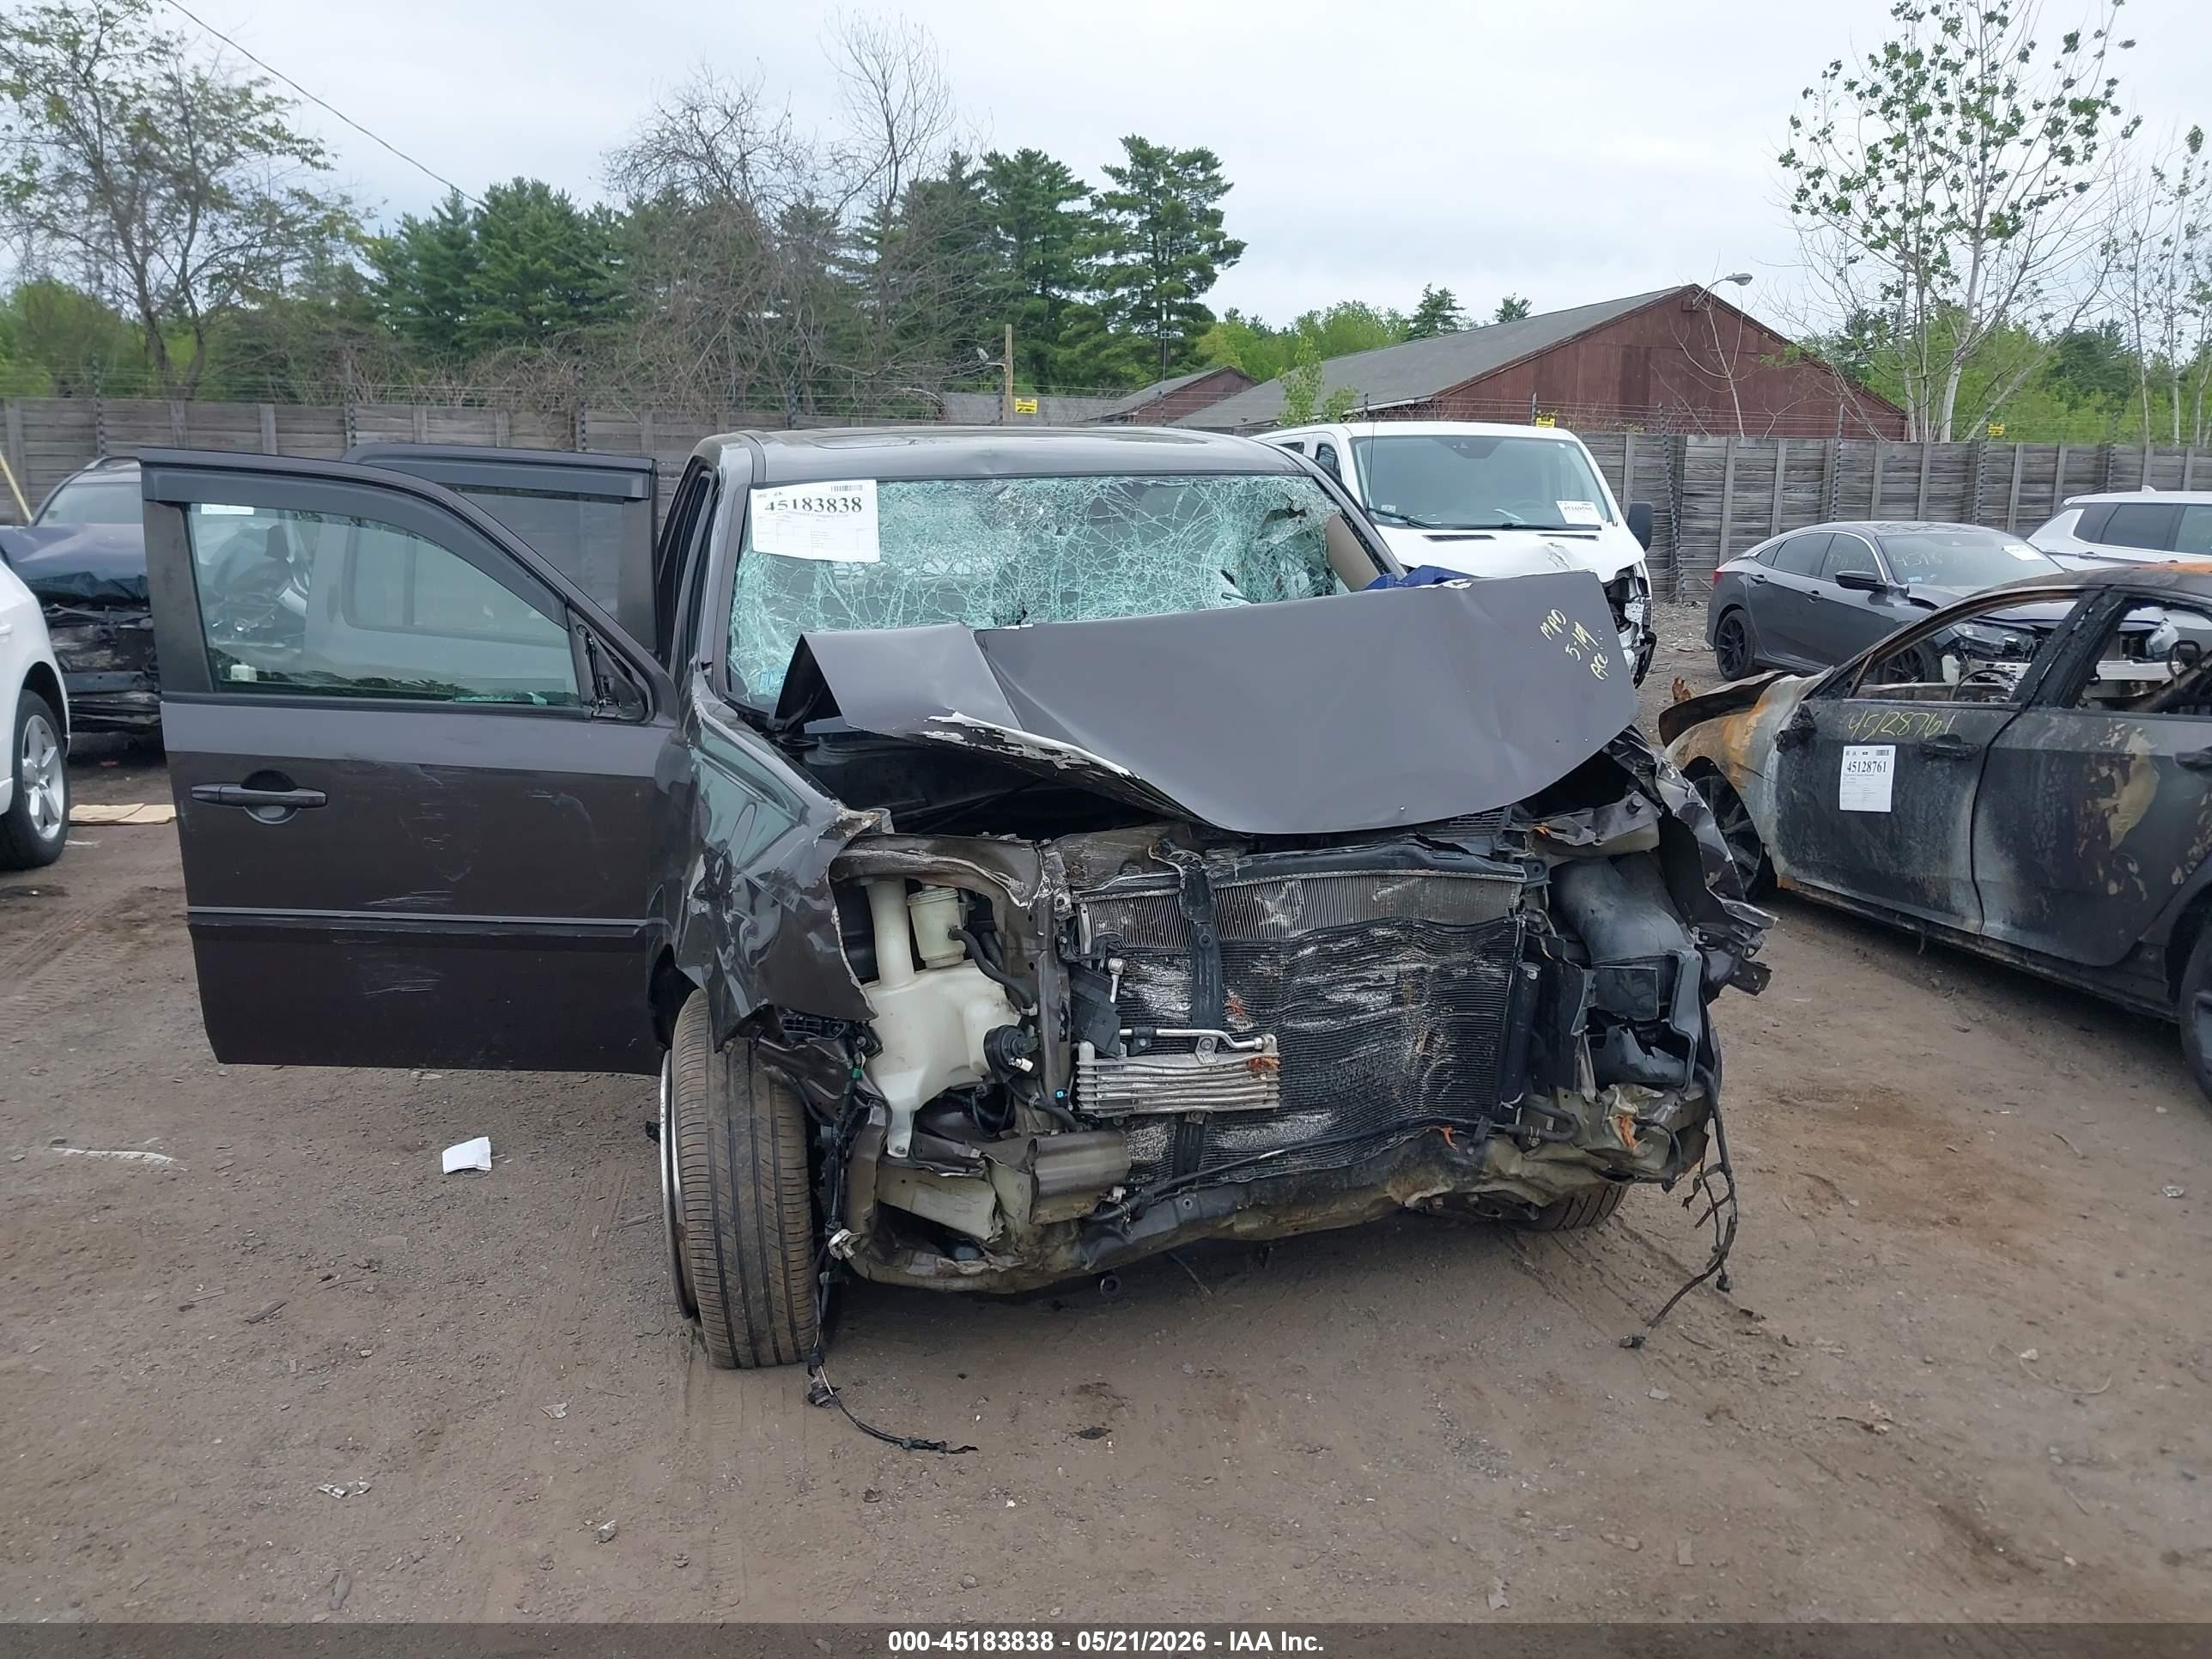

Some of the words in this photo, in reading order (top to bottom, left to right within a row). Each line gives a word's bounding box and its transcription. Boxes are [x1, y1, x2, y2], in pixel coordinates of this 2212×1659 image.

[764, 496, 863, 514] 45183838
[1848, 710, 1956, 743] 45128761
[1847, 761, 1887, 773] 45128761
